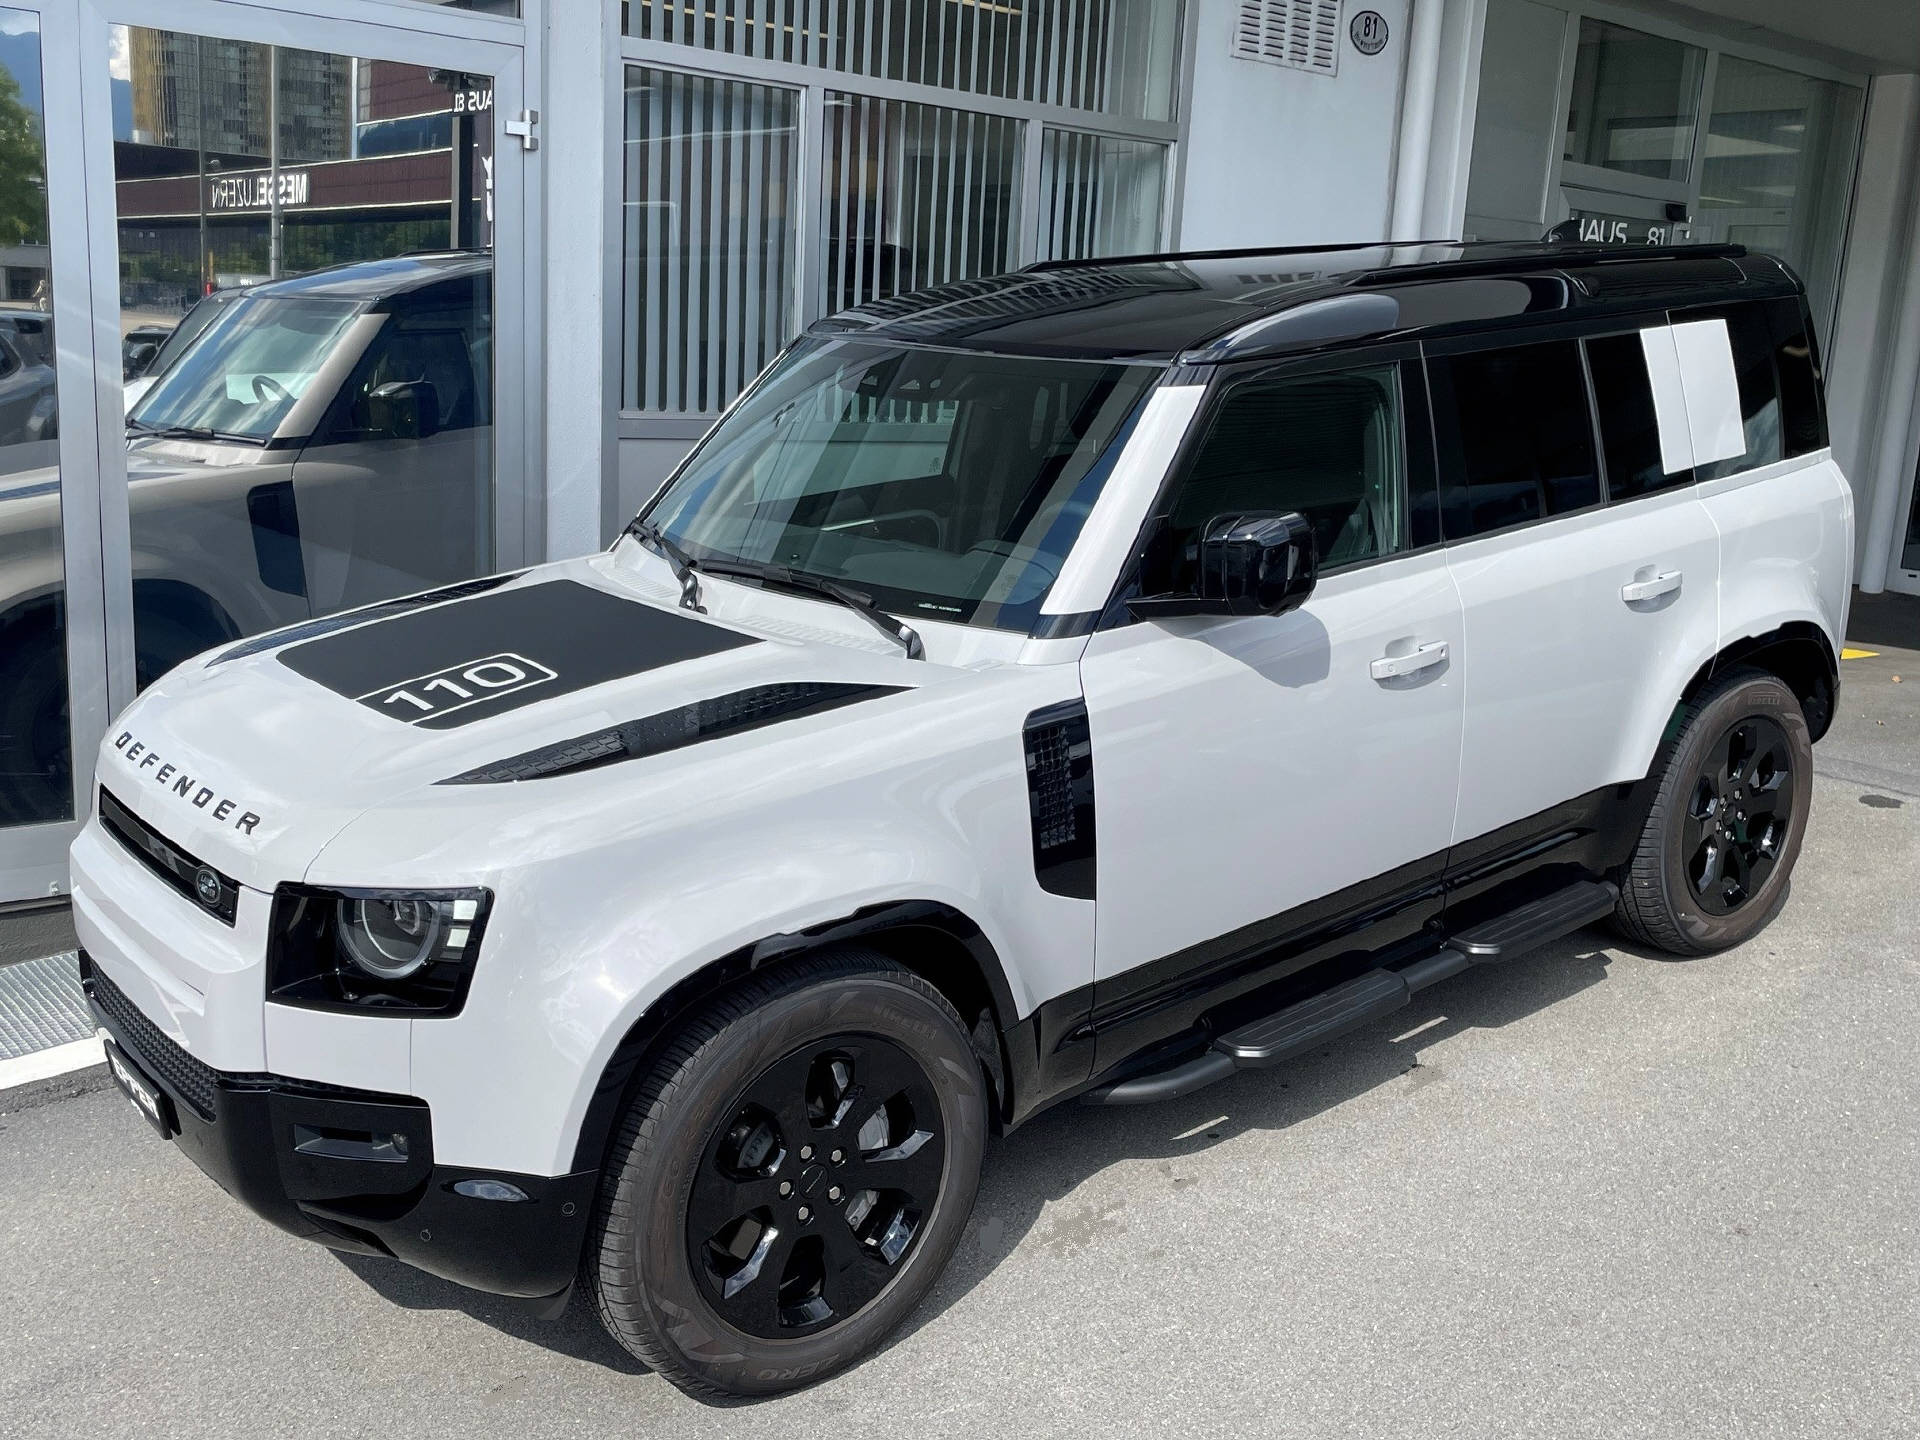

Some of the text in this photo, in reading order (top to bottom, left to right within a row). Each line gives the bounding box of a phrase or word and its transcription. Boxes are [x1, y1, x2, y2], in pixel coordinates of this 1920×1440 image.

[1363, 15, 1379, 39] 81
[1646, 227, 1665, 245] 81
[384, 663, 526, 711] 110
[115, 731, 261, 835] DEFENDER
